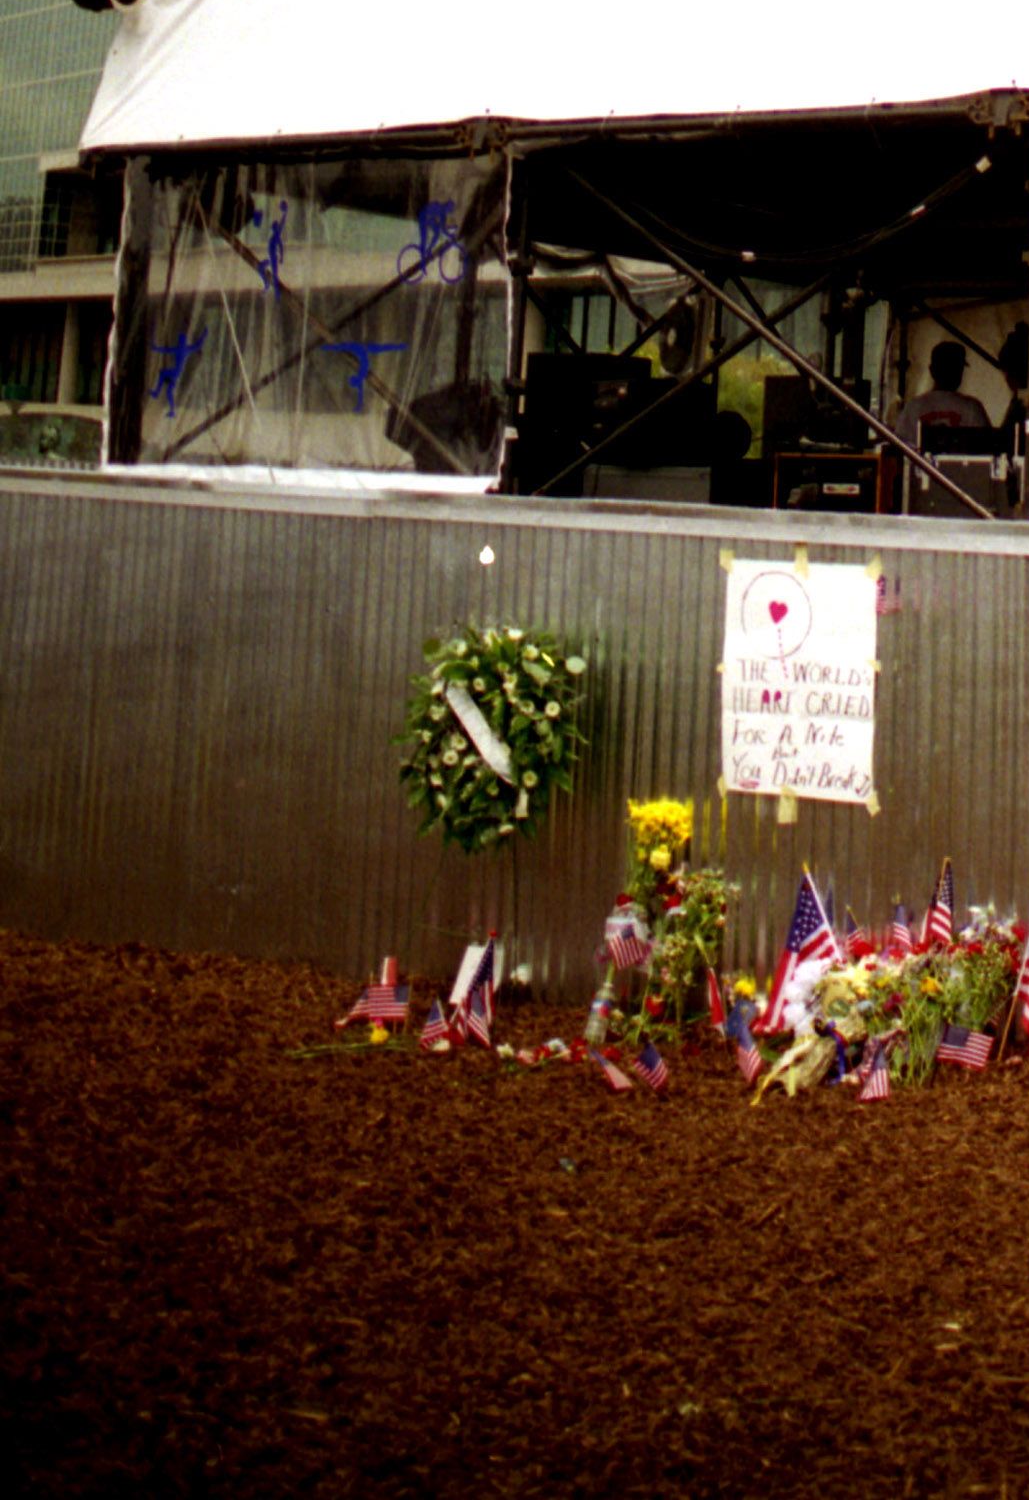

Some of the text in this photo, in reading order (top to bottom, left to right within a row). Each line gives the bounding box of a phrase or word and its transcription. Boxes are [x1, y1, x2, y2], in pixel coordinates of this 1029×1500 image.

[737, 658, 768, 682] THE
[732, 687, 870, 718] HEART CRIED
